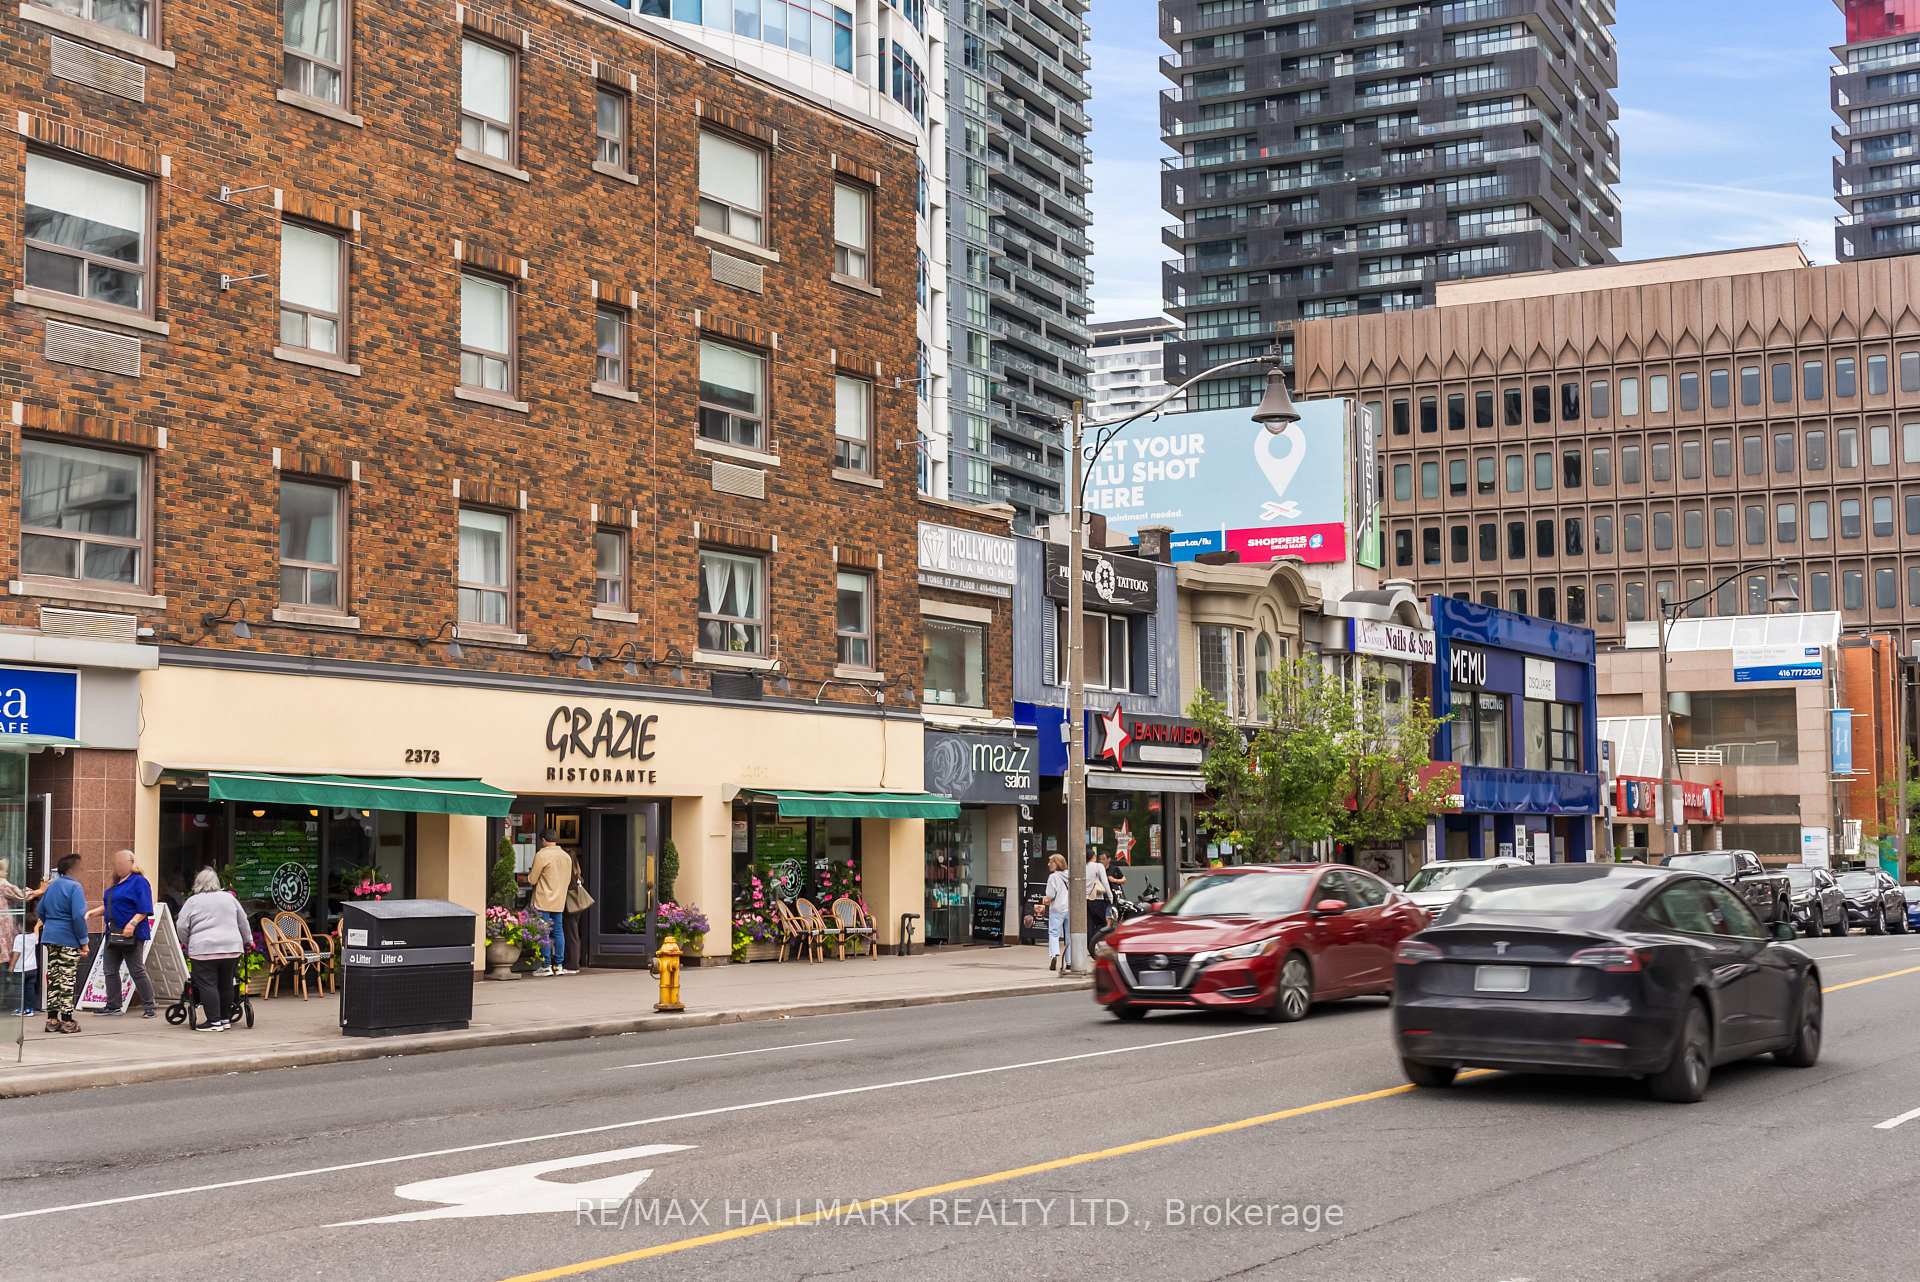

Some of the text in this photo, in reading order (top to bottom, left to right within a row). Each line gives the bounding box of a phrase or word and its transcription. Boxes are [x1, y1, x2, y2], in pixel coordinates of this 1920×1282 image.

[1133, 434, 1206, 459] YOUR
[1132, 458, 1199, 483] SHOT
[1084, 486, 1145, 510] HERE
[950, 532, 1015, 567] HOLLYWOOD
[1247, 536, 1307, 547] SHOPPERS
[950, 560, 1015, 580] DIAMOND
[1116, 576, 1148, 592] TATTOOS
[1385, 627, 1407, 653] Nails
[1409, 631, 1417, 654] &
[1418, 633, 1433, 660] Spa
[1450, 648, 1486, 686] MEMU
[1778, 669, 1790, 677] 416
[1803, 668, 1822, 676] 2200
[545, 705, 659, 763] GRAZIE
[1134, 721, 1168, 742] BANH
[1170, 726, 1182, 743] MI
[405, 749, 440, 764] 2373
[972, 743, 1031, 773] mazz
[546, 767, 657, 783] RISTORANTE
[1004, 773, 1031, 789] salon
[356, 953, 371, 964] Litter
[381, 954, 397, 964] Litter
